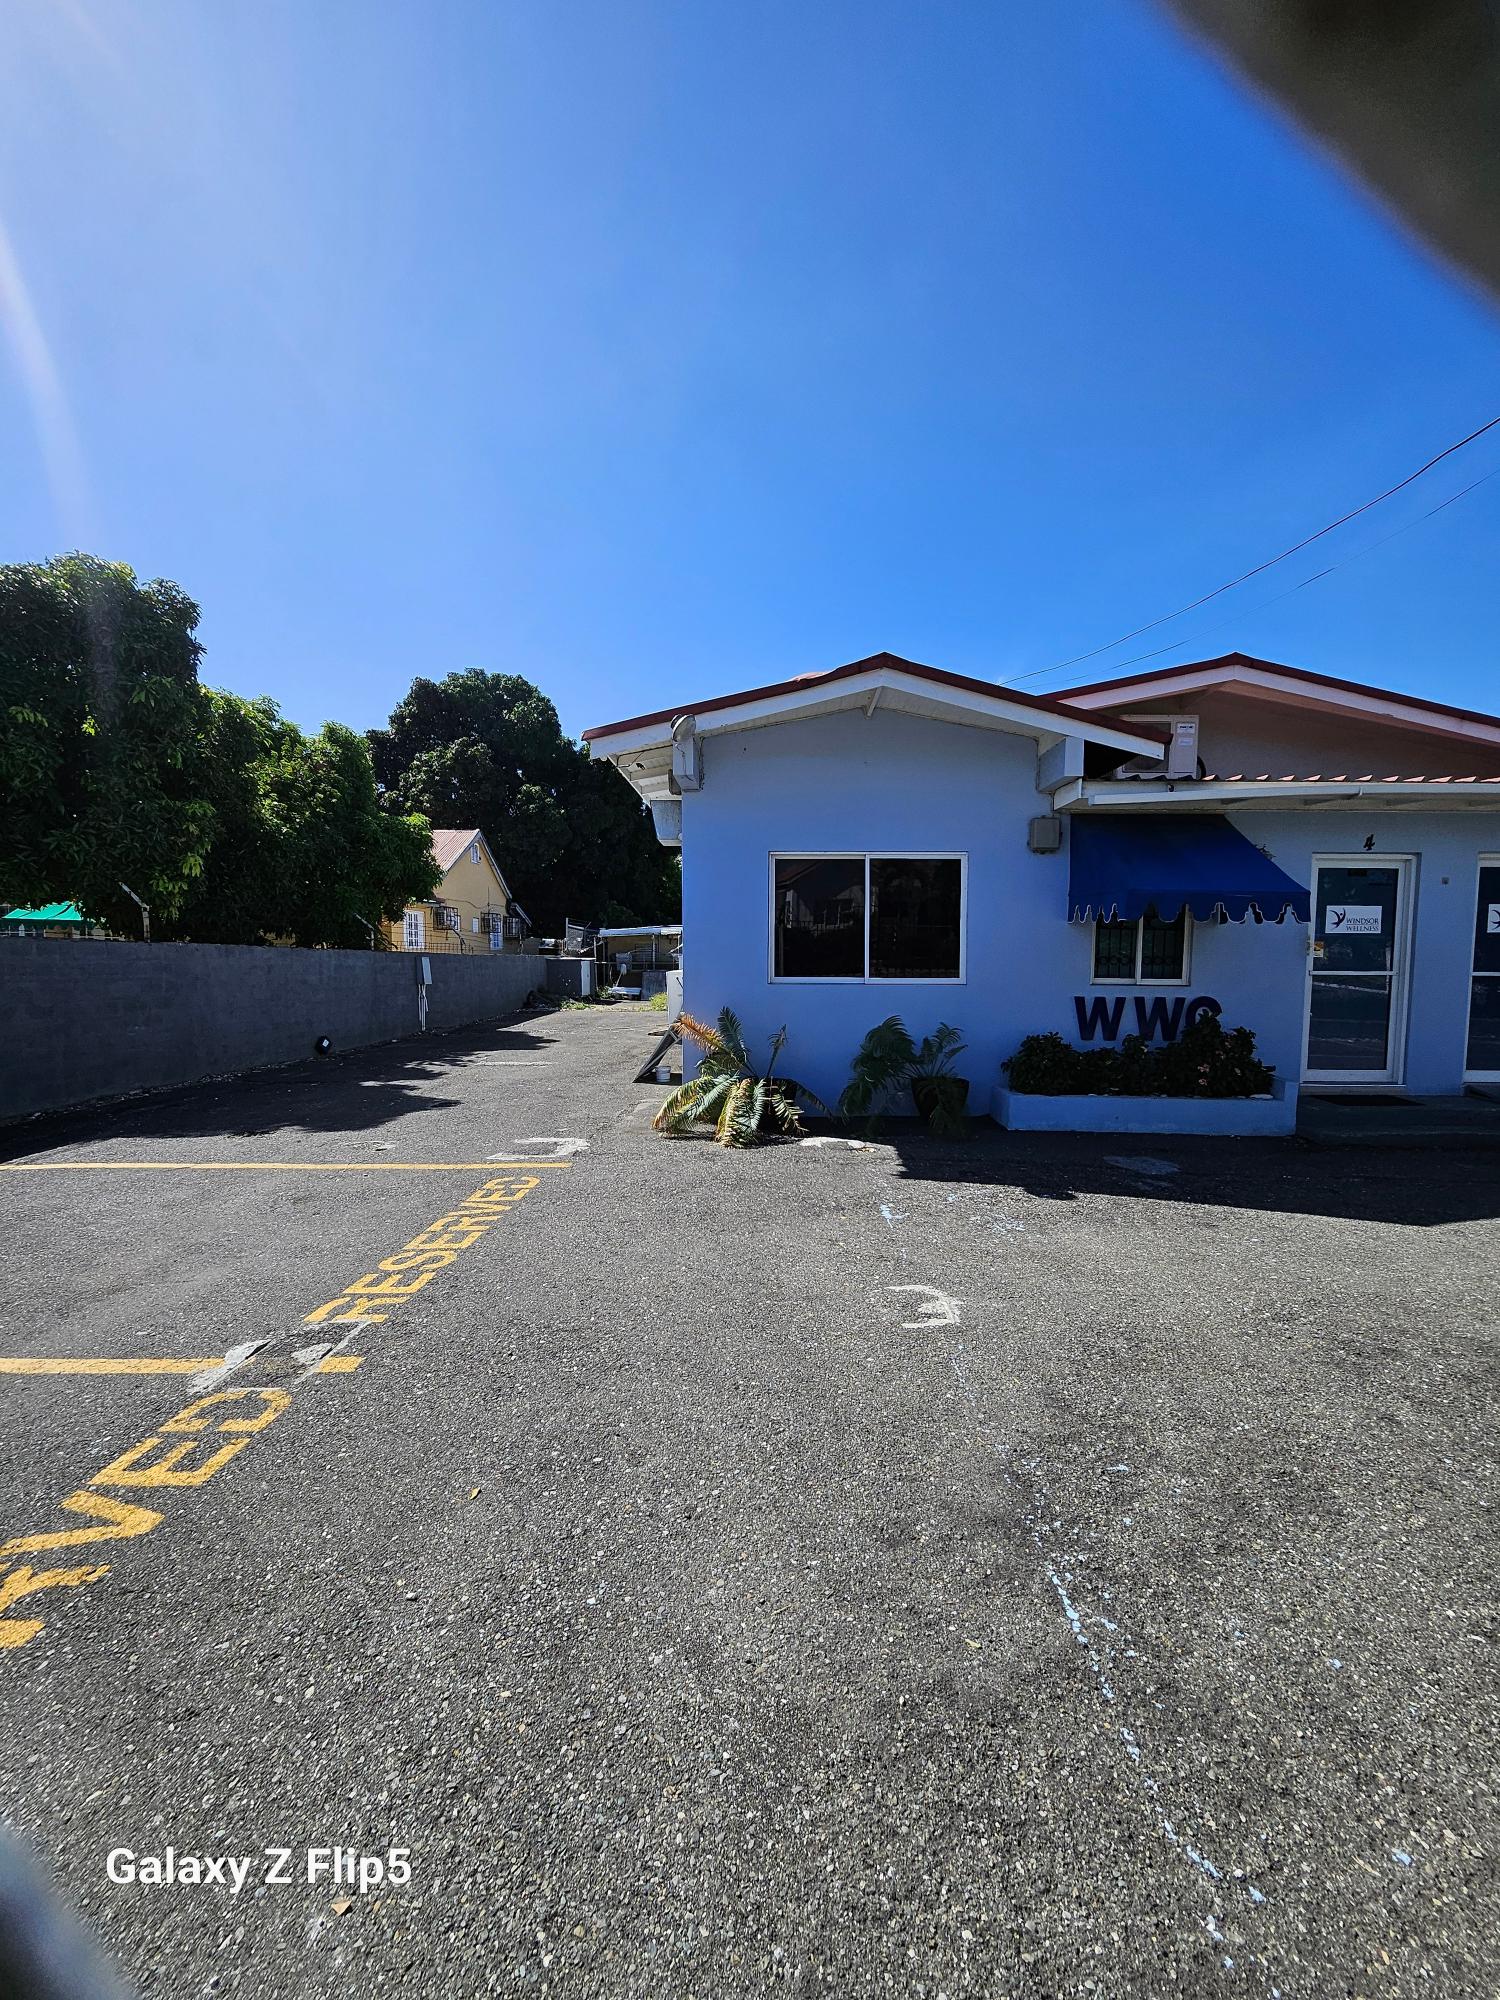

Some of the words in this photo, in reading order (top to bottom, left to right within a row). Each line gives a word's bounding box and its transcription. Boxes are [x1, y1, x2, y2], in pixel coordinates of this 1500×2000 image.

[1363, 833, 1376, 851] 4
[1346, 917, 1379, 925] WINDSOR
[303, 1174, 541, 1323] RESERVED
